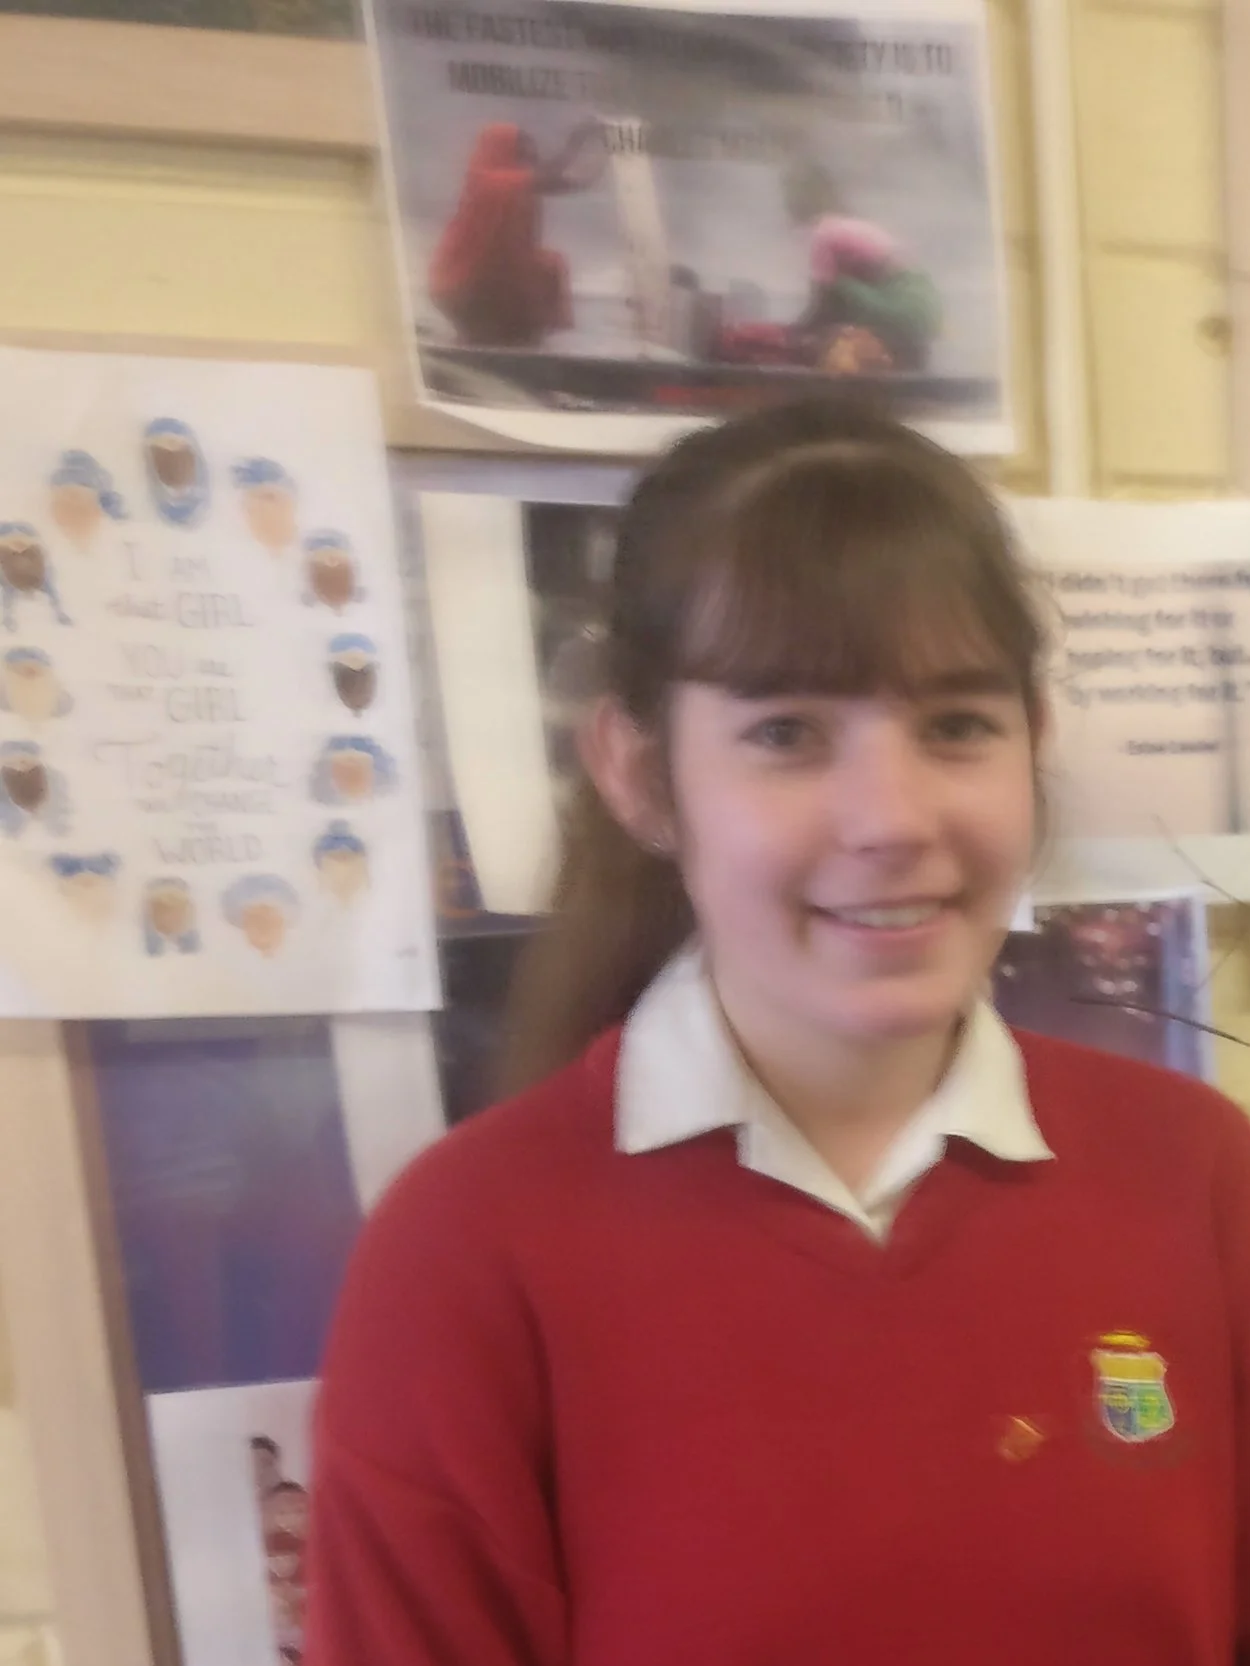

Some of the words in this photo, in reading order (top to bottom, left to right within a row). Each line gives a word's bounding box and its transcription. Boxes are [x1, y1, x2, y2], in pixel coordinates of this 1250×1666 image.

[448, 60, 572, 100] MOBILIZE
[176, 591, 256, 629] GIRL
[119, 644, 183, 680] YOU
[165, 685, 247, 724] GIRL
[92, 732, 290, 792] Together
[153, 834, 264, 865] WORLD
